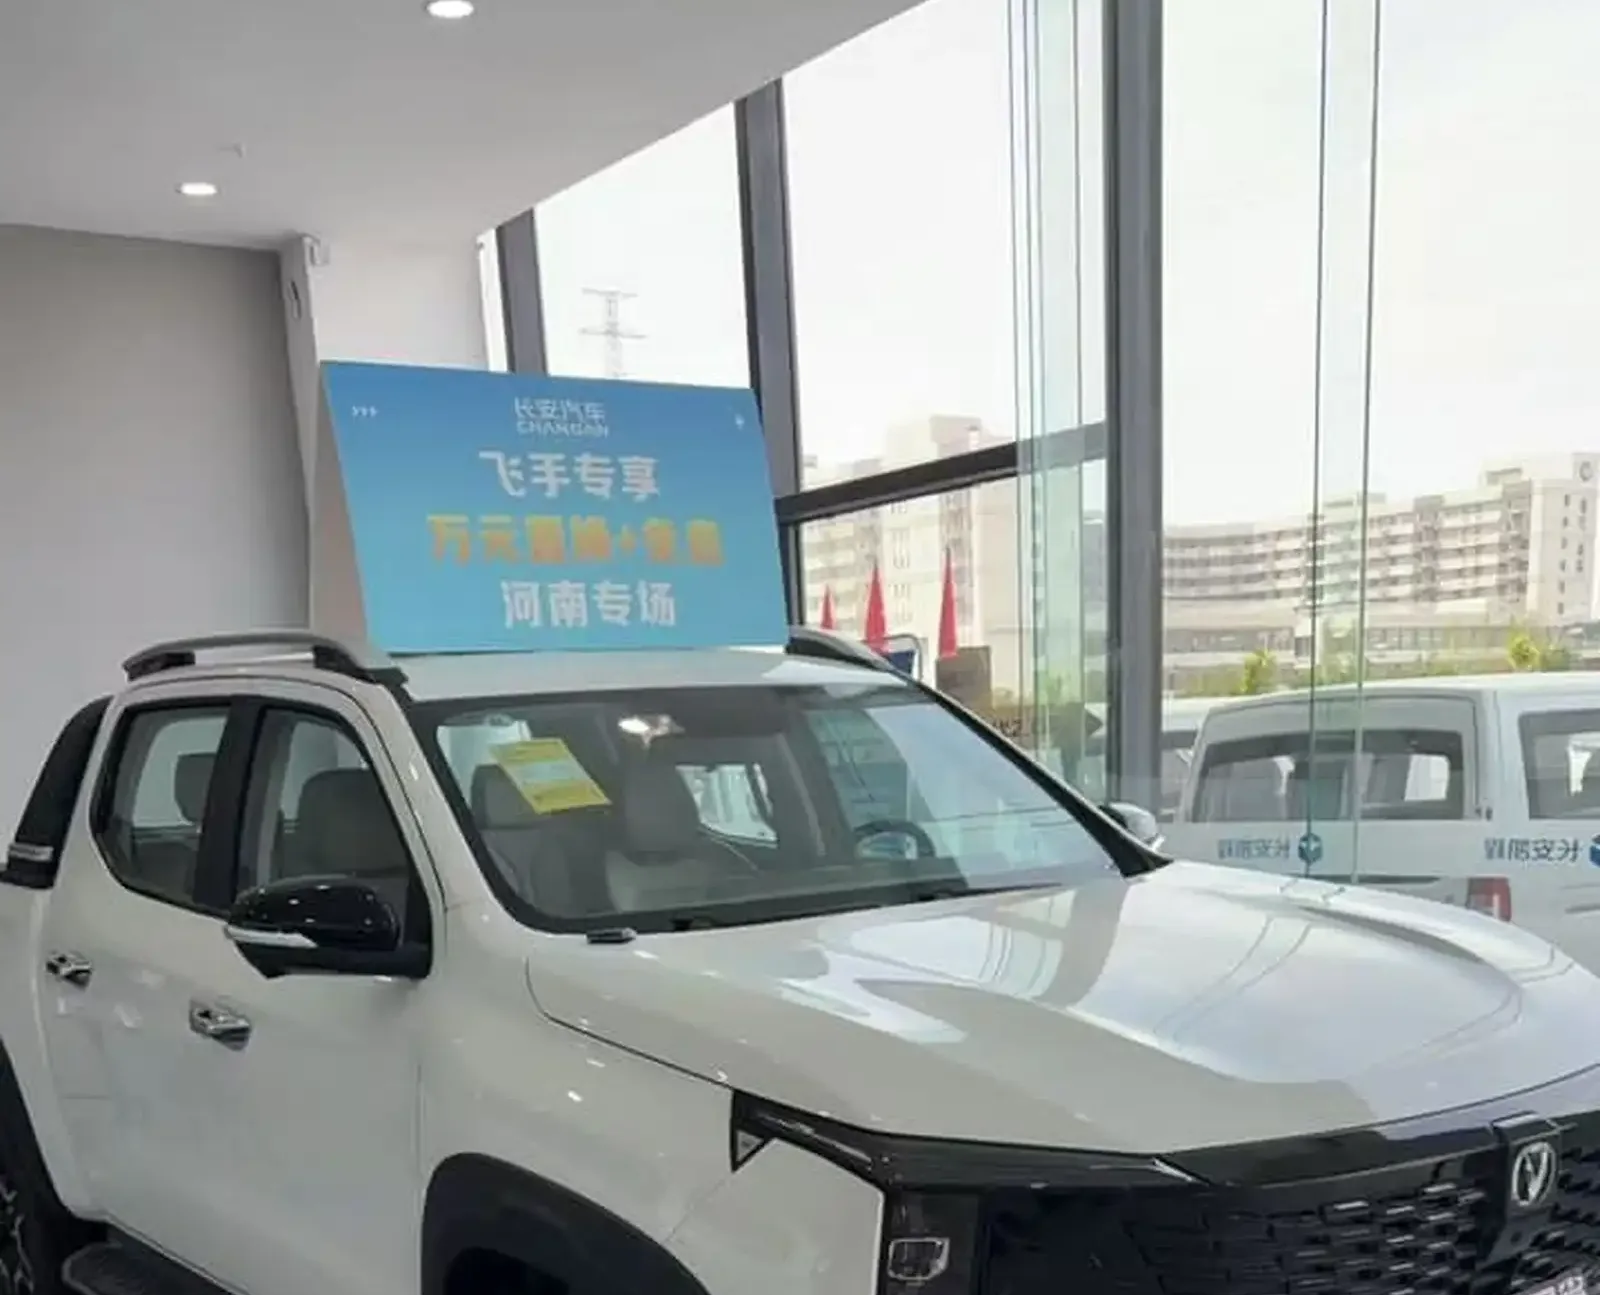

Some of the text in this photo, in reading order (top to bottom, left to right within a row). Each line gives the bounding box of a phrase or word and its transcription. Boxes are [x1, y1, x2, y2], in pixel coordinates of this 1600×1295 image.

[514, 396, 606, 422] 长安汽车
[479, 450, 660, 502] 飞手专享
[500, 579, 677, 629] 河南专场
